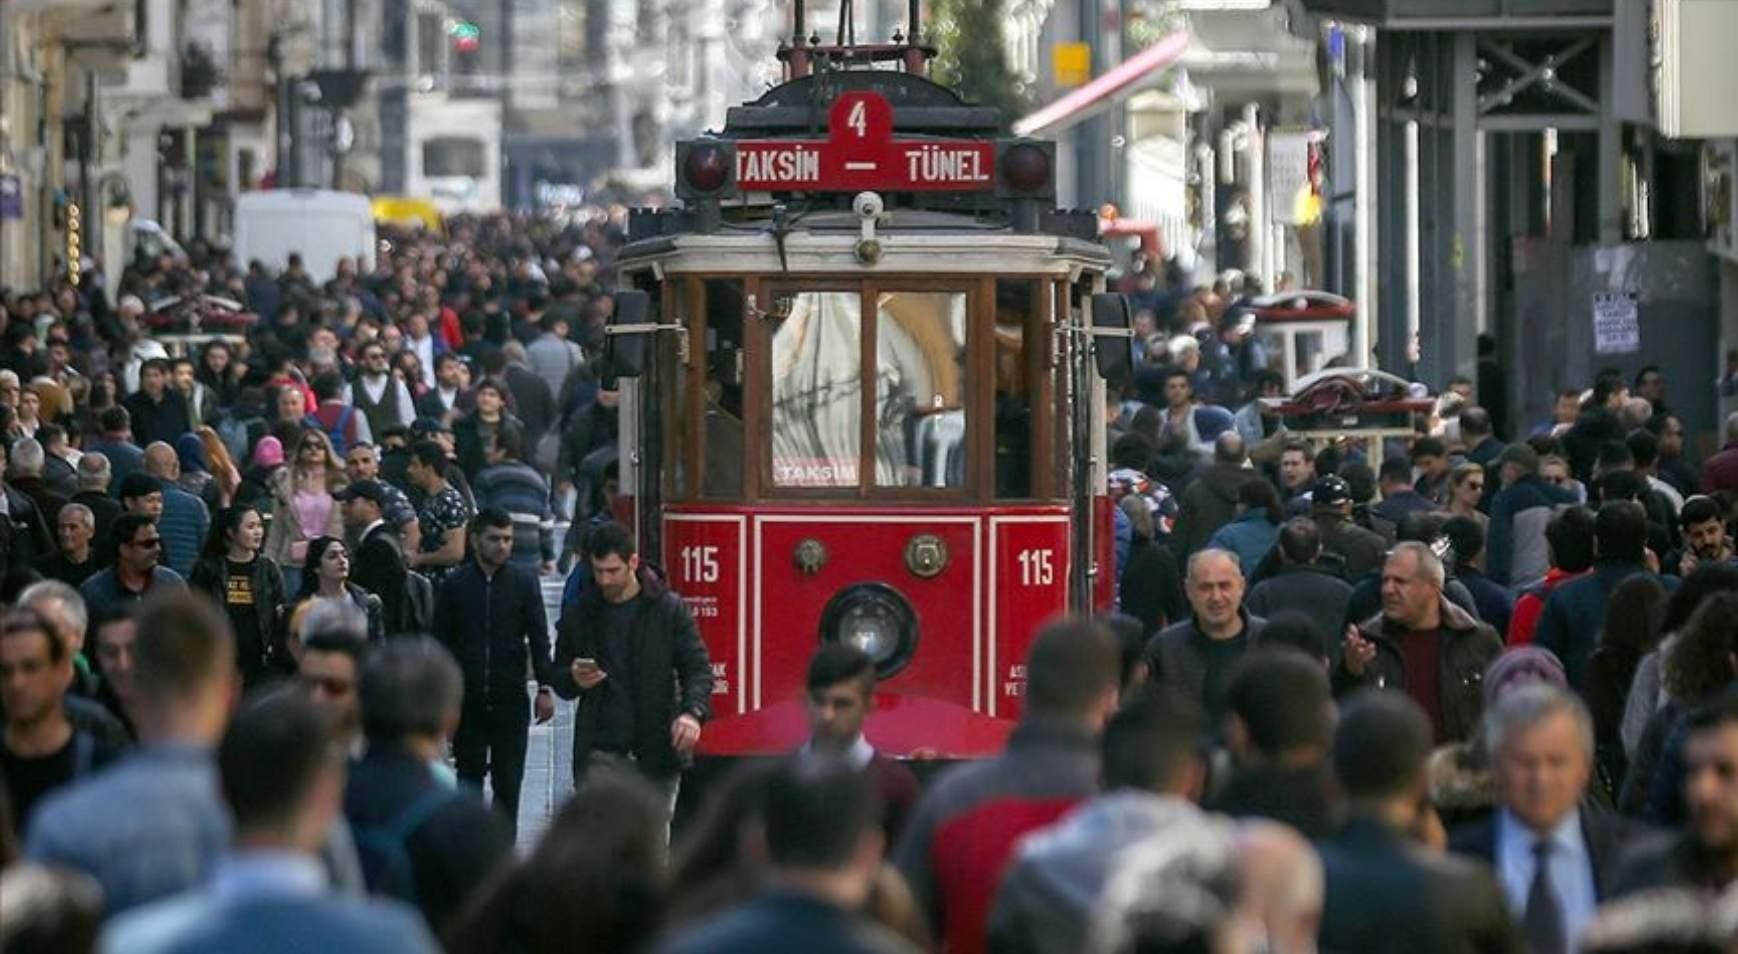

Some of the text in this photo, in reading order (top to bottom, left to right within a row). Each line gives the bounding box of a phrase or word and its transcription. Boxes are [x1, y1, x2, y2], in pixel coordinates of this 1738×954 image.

[848, 100, 867, 137] 4
[735, 145, 820, 181] TAKSİM
[905, 145, 990, 181] TÜNEL
[681, 545, 719, 582] 115
[1018, 549, 1053, 586] 115
